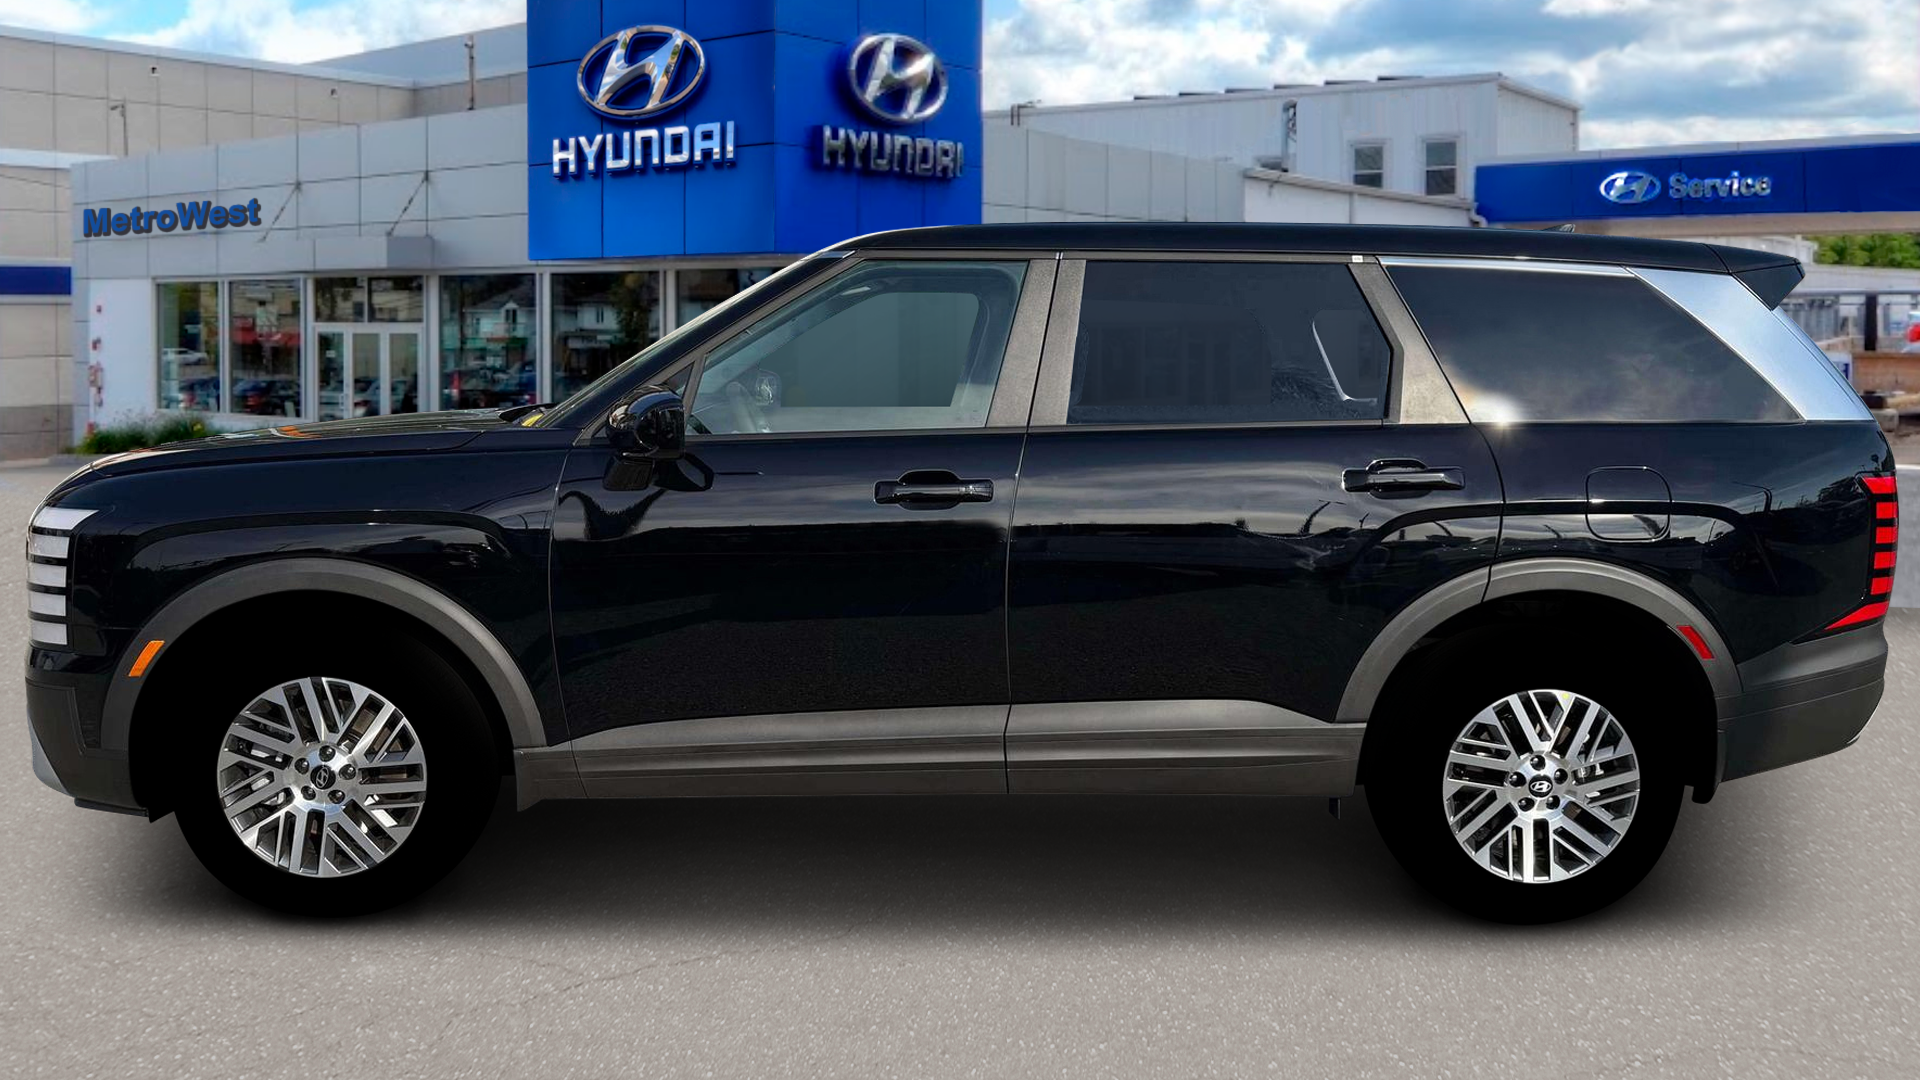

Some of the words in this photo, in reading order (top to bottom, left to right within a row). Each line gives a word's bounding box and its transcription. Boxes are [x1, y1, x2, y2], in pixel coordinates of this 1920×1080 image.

[552, 121, 735, 175] HYUNDAI
[822, 124, 964, 178] HYUNDAI
[1668, 171, 1771, 198] Service
[83, 198, 261, 237] MetroWest
